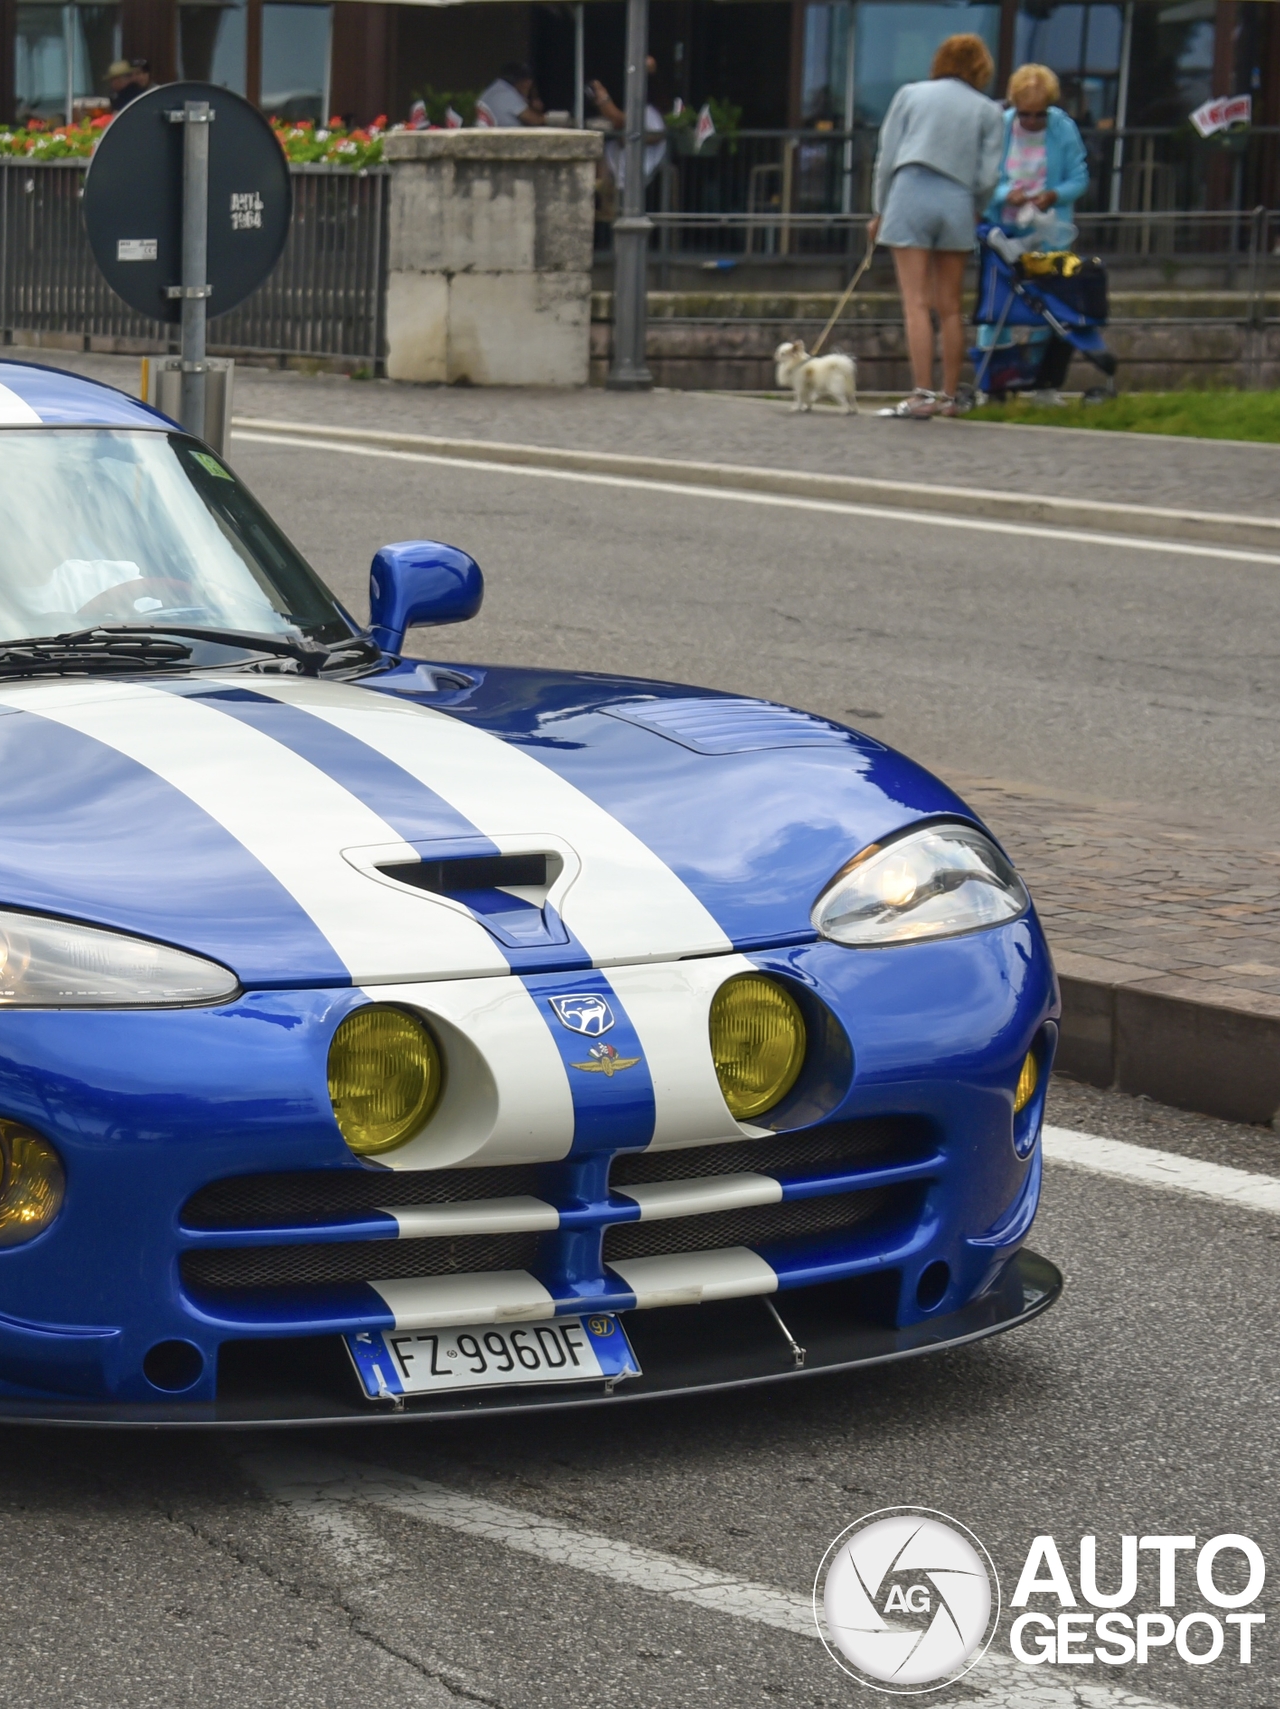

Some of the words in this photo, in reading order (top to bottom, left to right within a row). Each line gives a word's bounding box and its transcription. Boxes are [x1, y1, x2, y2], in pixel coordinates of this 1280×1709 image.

[591, 1318, 609, 1334] 97
[389, 1334, 453, 1378] FZ
[456, 1323, 585, 1374] 996DF
